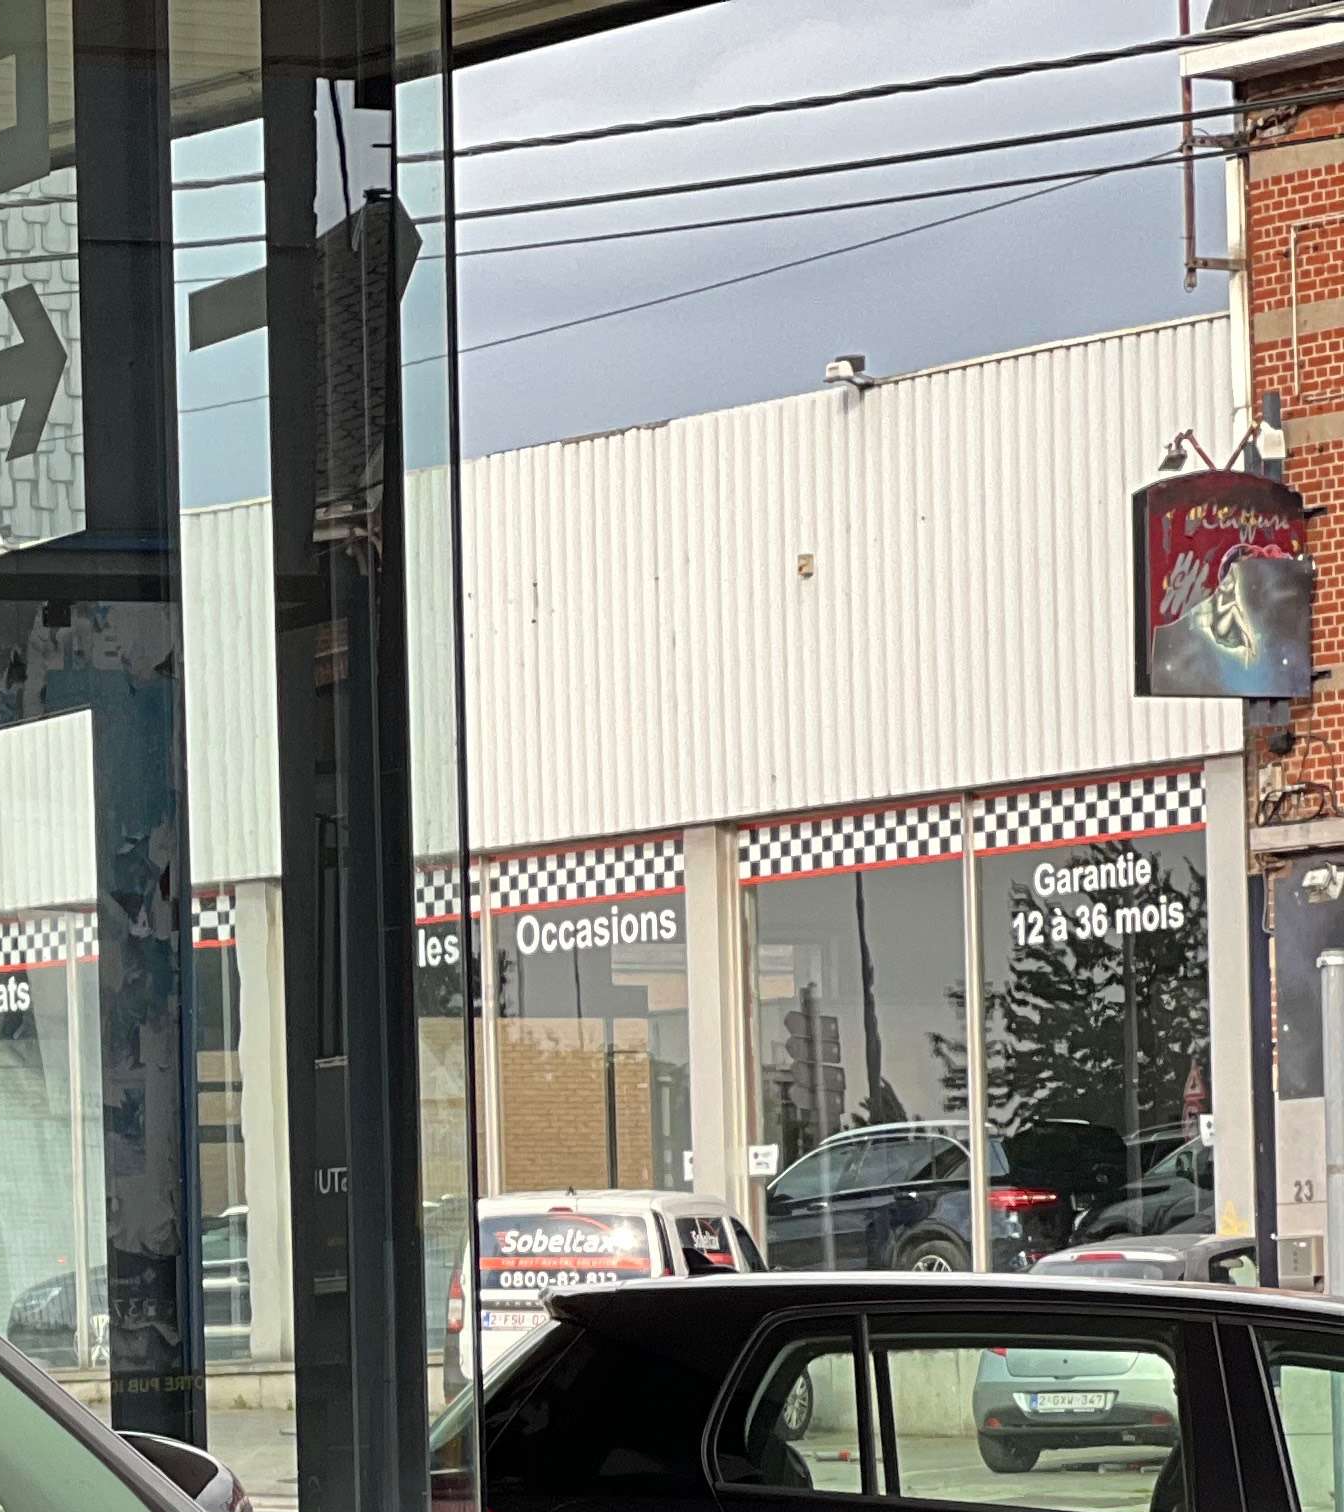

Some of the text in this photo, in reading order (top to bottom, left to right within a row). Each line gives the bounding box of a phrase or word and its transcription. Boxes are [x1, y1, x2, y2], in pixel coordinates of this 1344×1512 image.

[1034, 853, 1151, 898] Garantie
[516, 906, 678, 955] Occasions
[1013, 896, 1185, 947] 12 à 36 mois
[1294, 1180, 1315, 1202] 23
